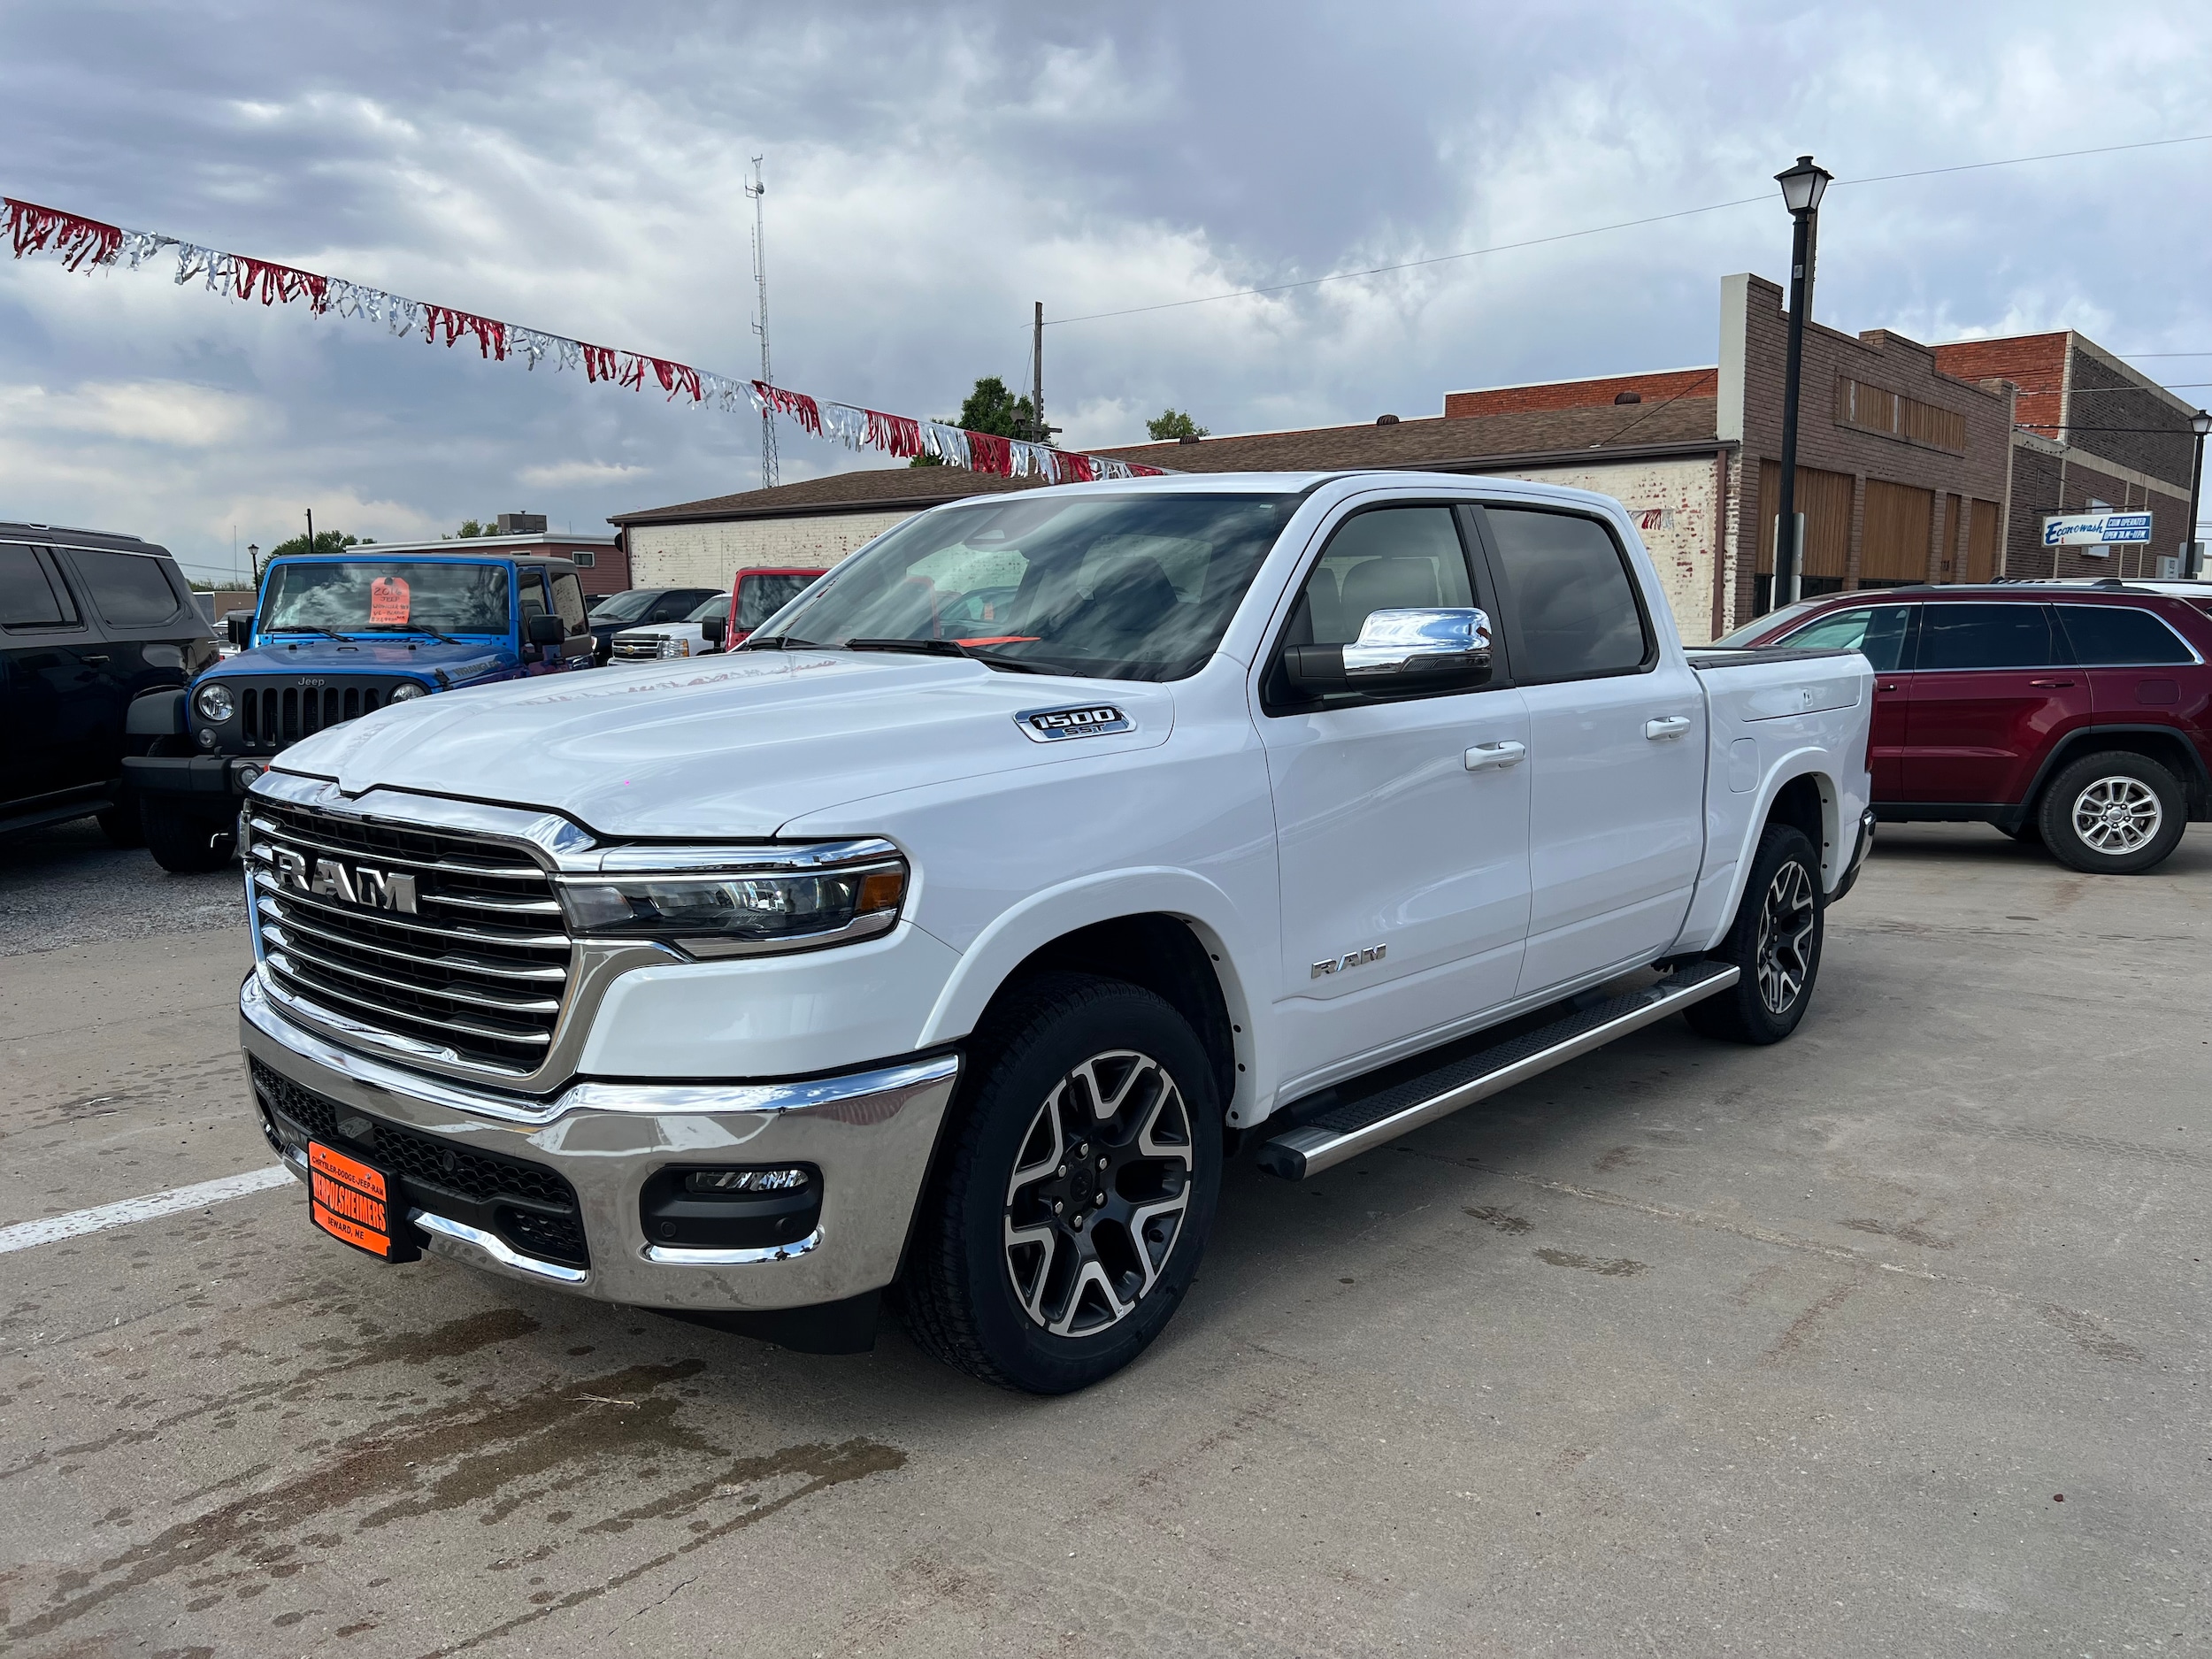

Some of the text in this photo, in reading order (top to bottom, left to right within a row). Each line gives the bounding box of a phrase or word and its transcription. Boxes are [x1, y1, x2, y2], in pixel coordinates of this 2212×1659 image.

[2108, 517, 2147, 526] COIN OPERATED
[2046, 519, 2103, 544] Econowash
[373, 587, 403, 596] 2016
[452, 660, 499, 676] WRANGLER
[297, 677, 326, 687] Jeep
[1033, 709, 1116, 729] 1500
[1062, 724, 1106, 737] SST
[272, 845, 418, 915] RAM
[1310, 943, 1386, 979] RAM
[327, 1216, 365, 1240] SEWARD, NE
